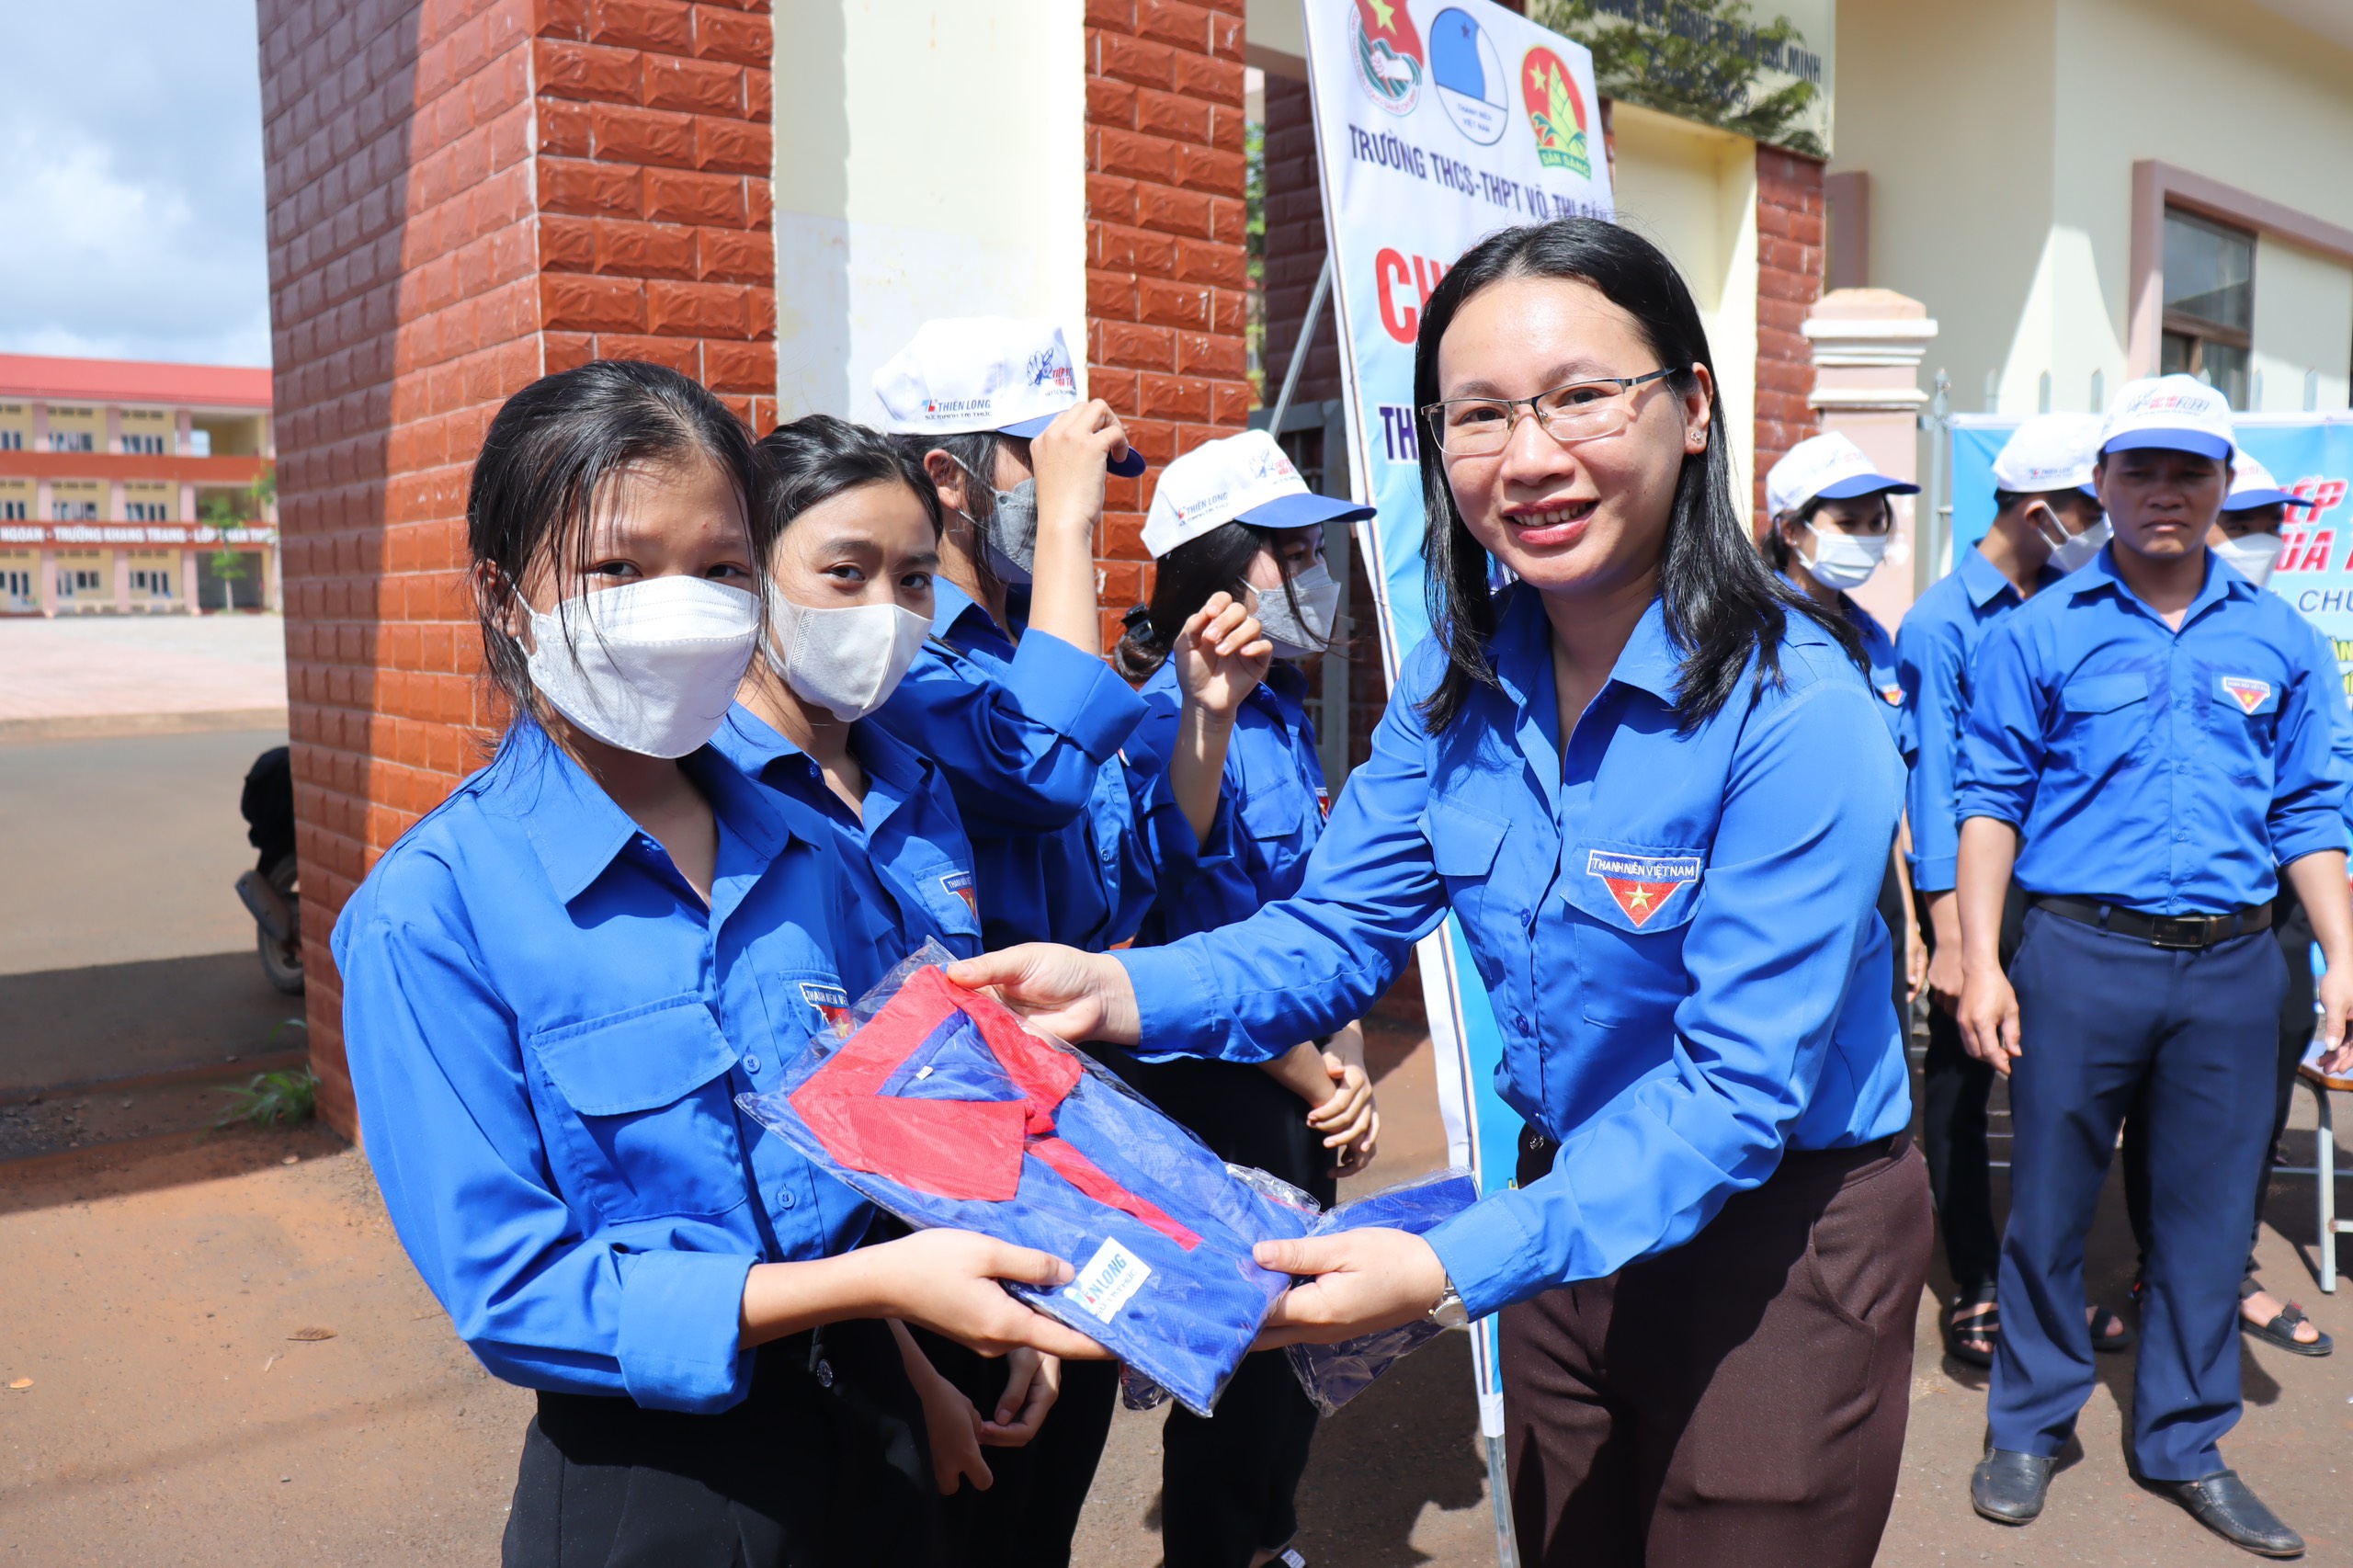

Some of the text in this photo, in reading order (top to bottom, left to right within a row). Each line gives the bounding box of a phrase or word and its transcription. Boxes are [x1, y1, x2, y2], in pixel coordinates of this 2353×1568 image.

[1788, 45, 1822, 84] MINH
[1348, 123, 1427, 179] TRƯỜNG
[1430, 152, 1521, 212] THCS-THPT
[938, 398, 992, 413] THIÊN LONG
[1208, 492, 1228, 506] LONG
[2279, 474, 2348, 525] ẾP
[1591, 858, 1695, 879] THANH NIÊN VIỆT NAM
[1097, 1254, 1128, 1289] LONG
